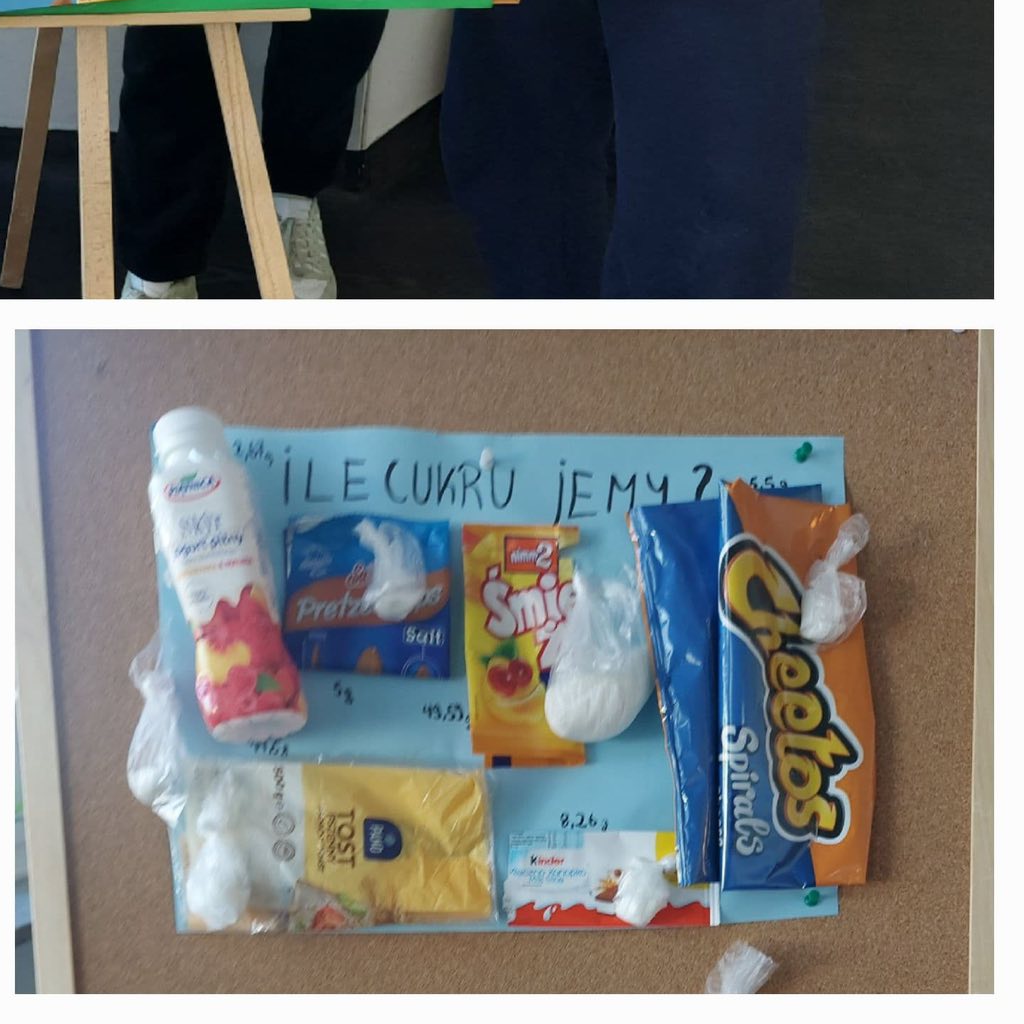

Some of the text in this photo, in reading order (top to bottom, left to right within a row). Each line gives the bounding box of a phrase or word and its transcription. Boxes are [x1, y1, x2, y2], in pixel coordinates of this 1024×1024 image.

[384, 458, 516, 511] CUKRU
[482, 563, 577, 640] Śmie
[720, 725, 771, 857] Spirals
[337, 807, 356, 870] TOST
